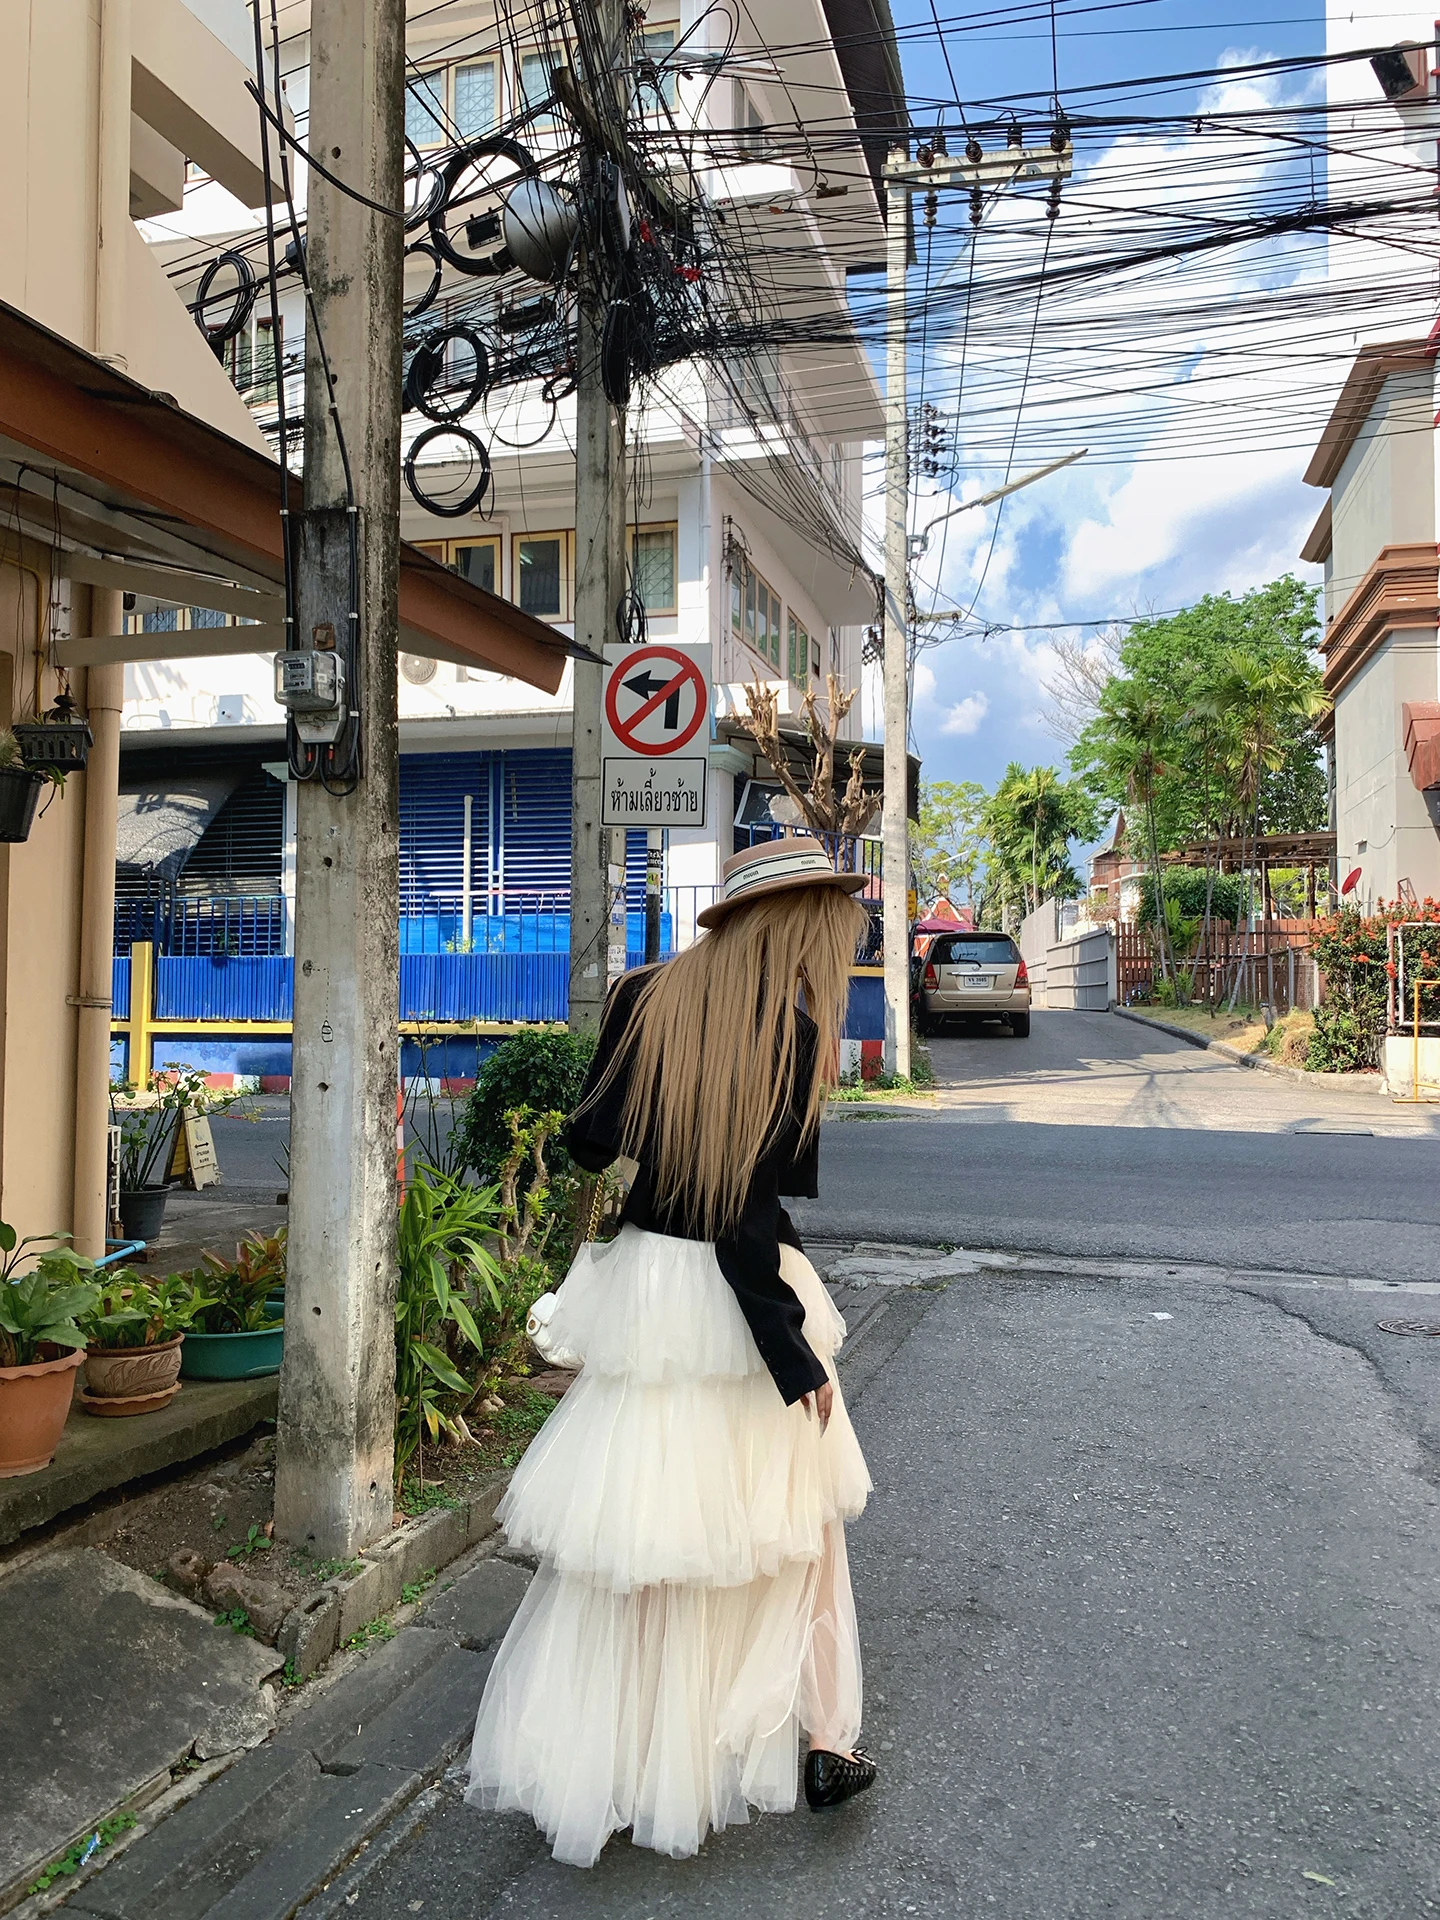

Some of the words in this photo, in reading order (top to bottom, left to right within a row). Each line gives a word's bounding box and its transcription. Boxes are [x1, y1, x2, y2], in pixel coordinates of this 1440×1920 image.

[611, 767, 698, 812] ห้ามเลี้ยวซ้าย
